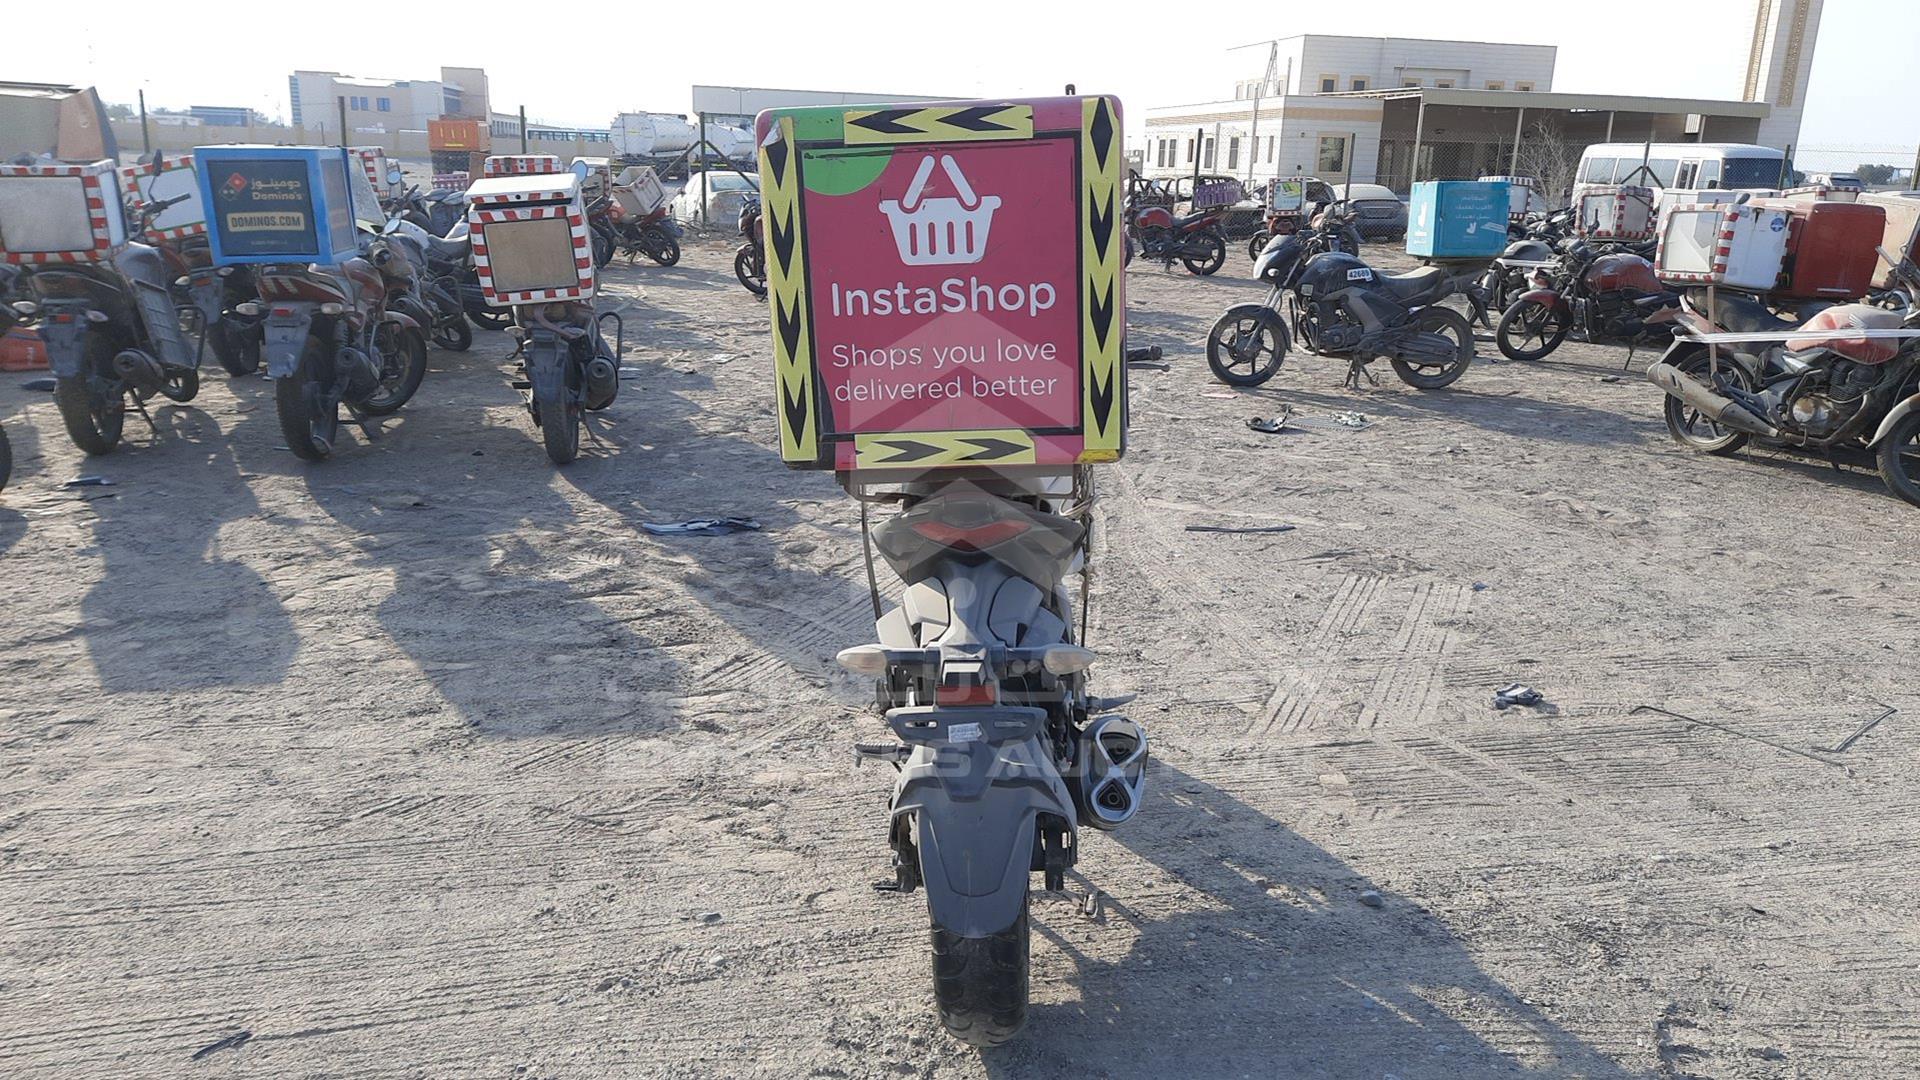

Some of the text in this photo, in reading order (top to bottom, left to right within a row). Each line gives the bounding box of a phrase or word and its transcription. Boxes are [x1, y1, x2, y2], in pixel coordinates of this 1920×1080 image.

[252, 191, 302, 200] Domino's
[231, 215, 301, 228] DOMINOS.COM
[831, 276, 1056, 317] InstaShop
[832, 338, 1057, 370] Shops you love
[834, 375, 1057, 402] delivered better
